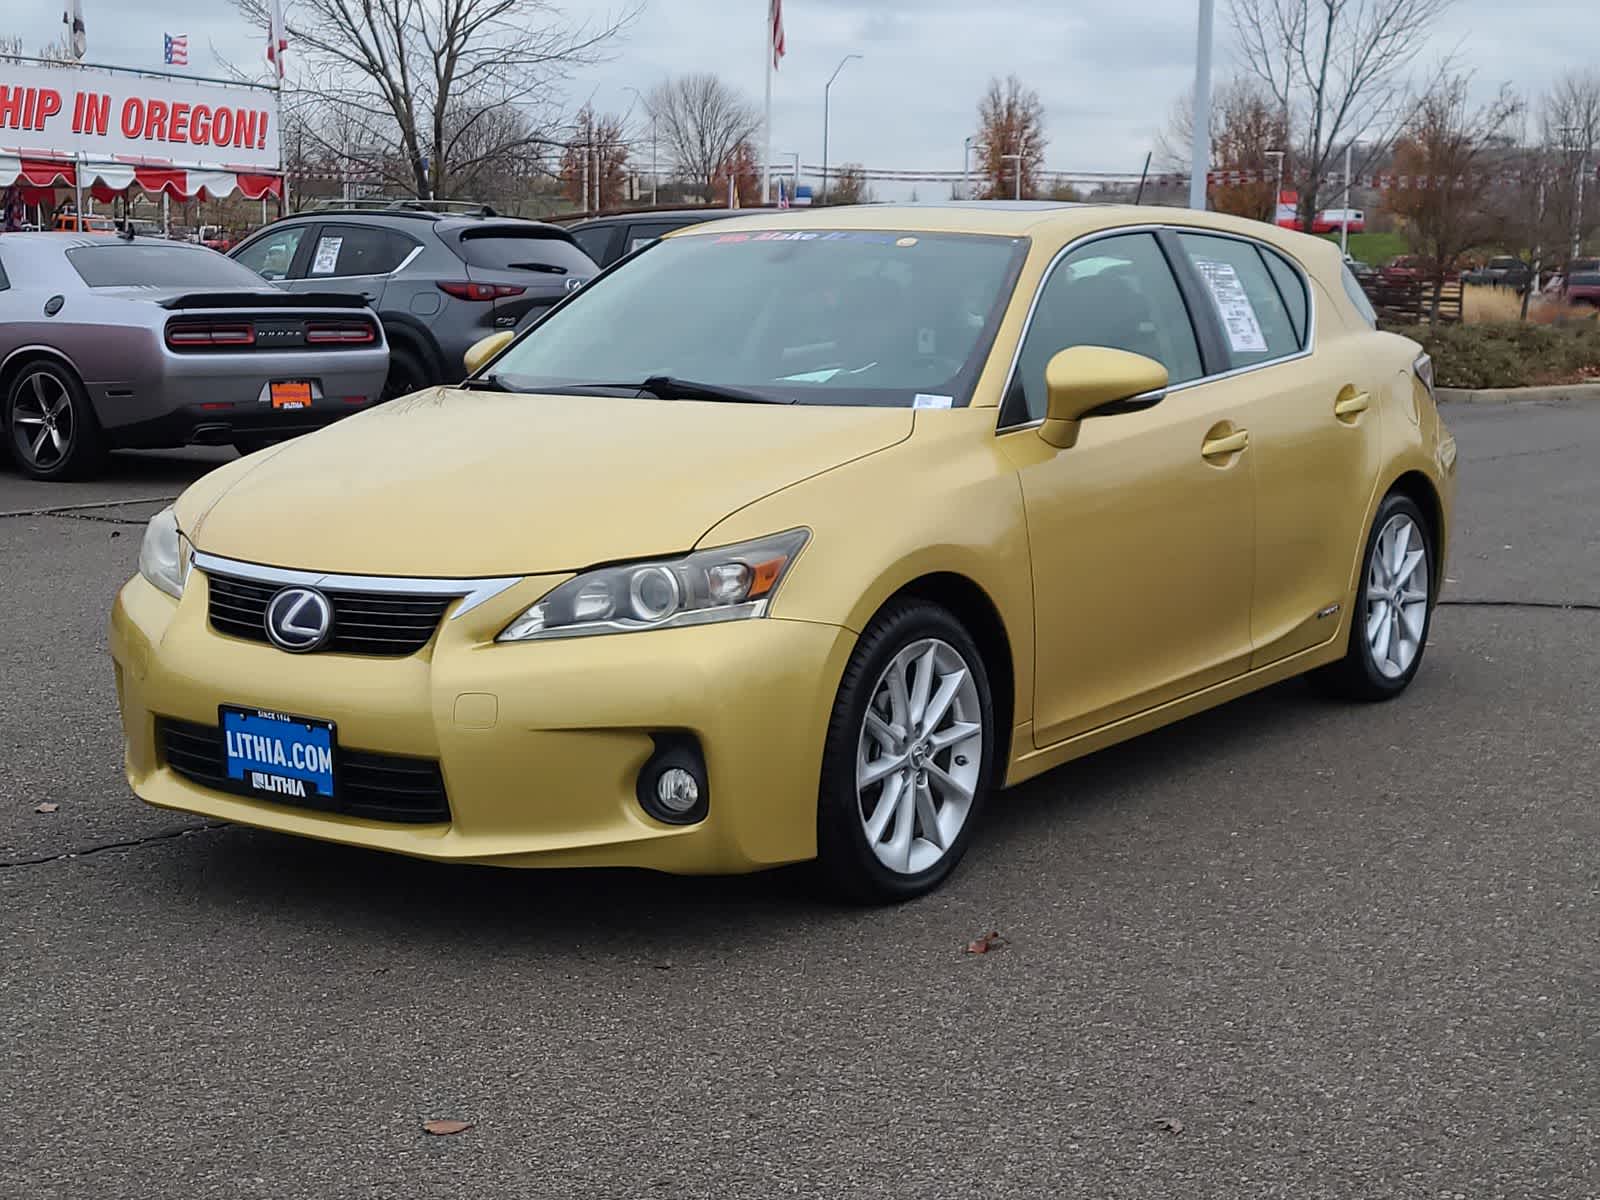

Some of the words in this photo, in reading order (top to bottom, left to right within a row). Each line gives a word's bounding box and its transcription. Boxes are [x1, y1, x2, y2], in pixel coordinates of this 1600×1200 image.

[71, 92, 111, 135] IN
[120, 96, 269, 149] OREGON!
[226, 730, 333, 775] LITHIA.COM
[264, 774, 306, 797] LITHIA
